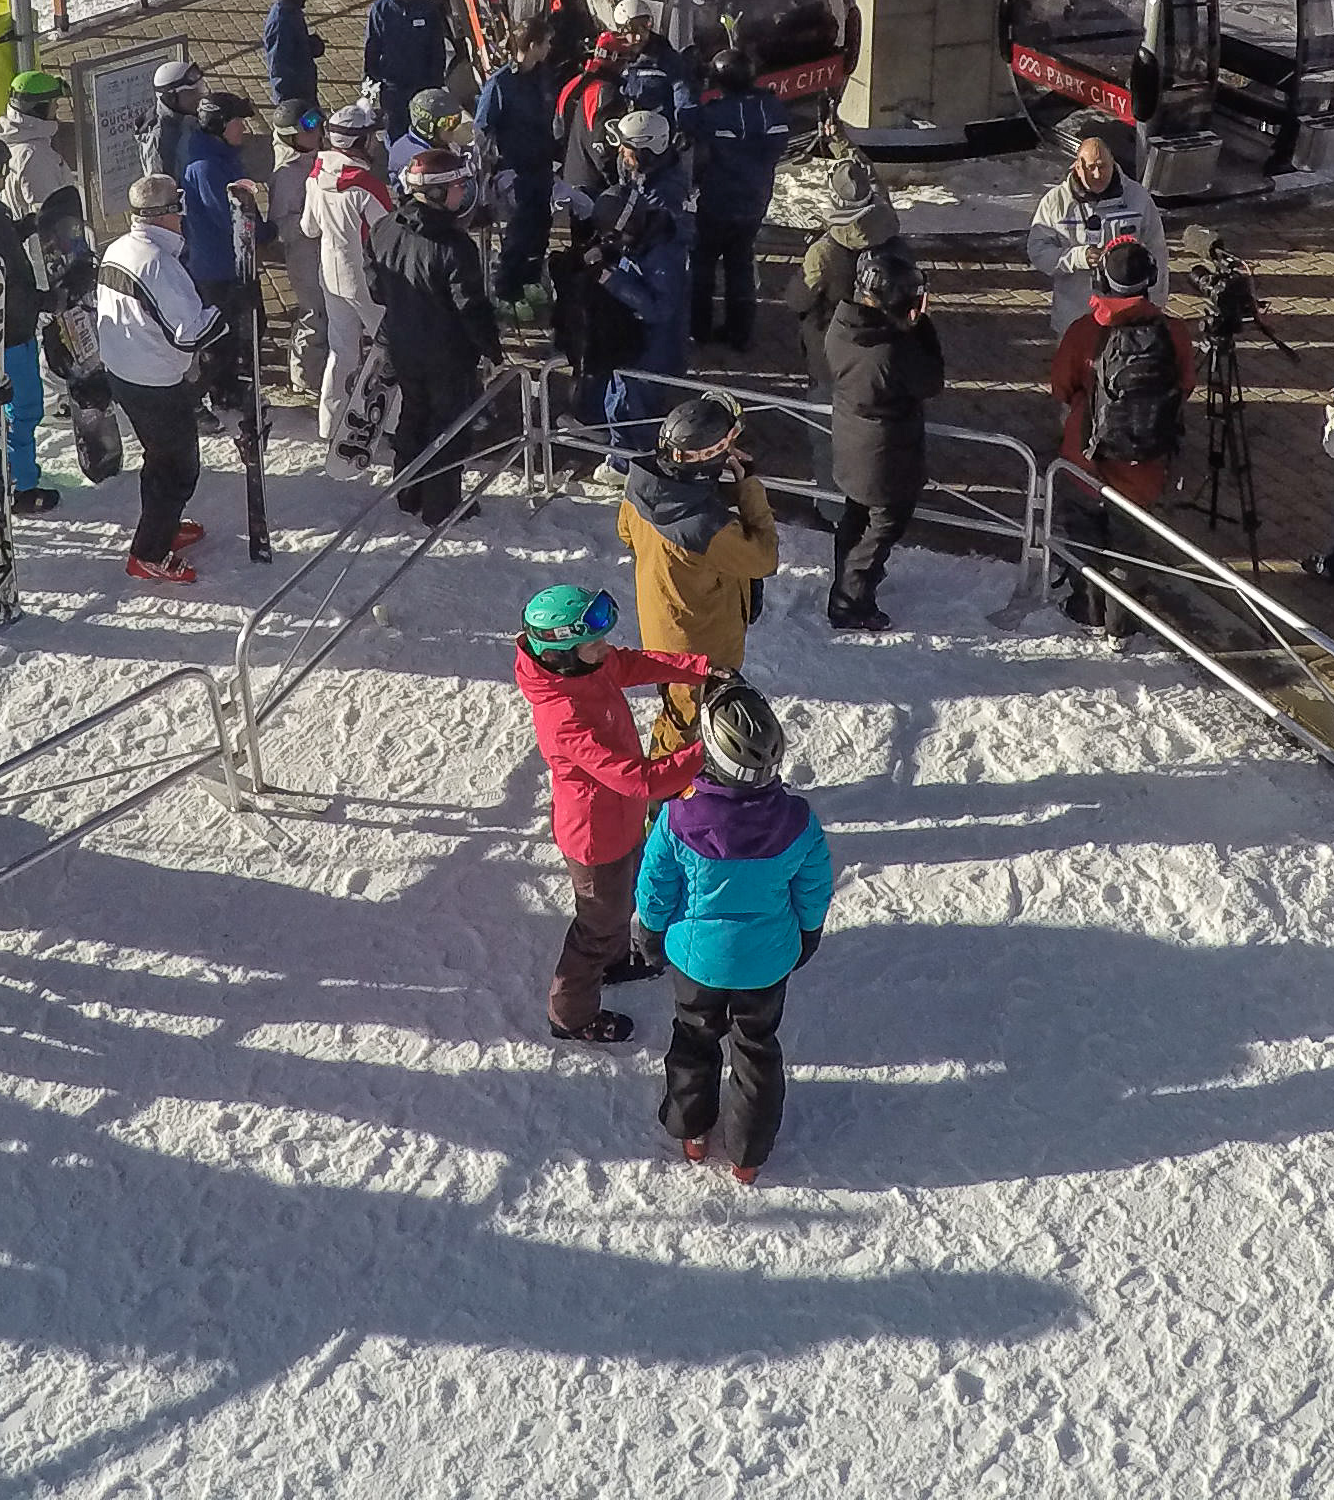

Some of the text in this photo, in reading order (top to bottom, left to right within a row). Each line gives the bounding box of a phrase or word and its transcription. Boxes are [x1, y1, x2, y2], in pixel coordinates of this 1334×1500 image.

[796, 64, 836, 89] CITY
[1046, 66, 1127, 115] PARK CITY
